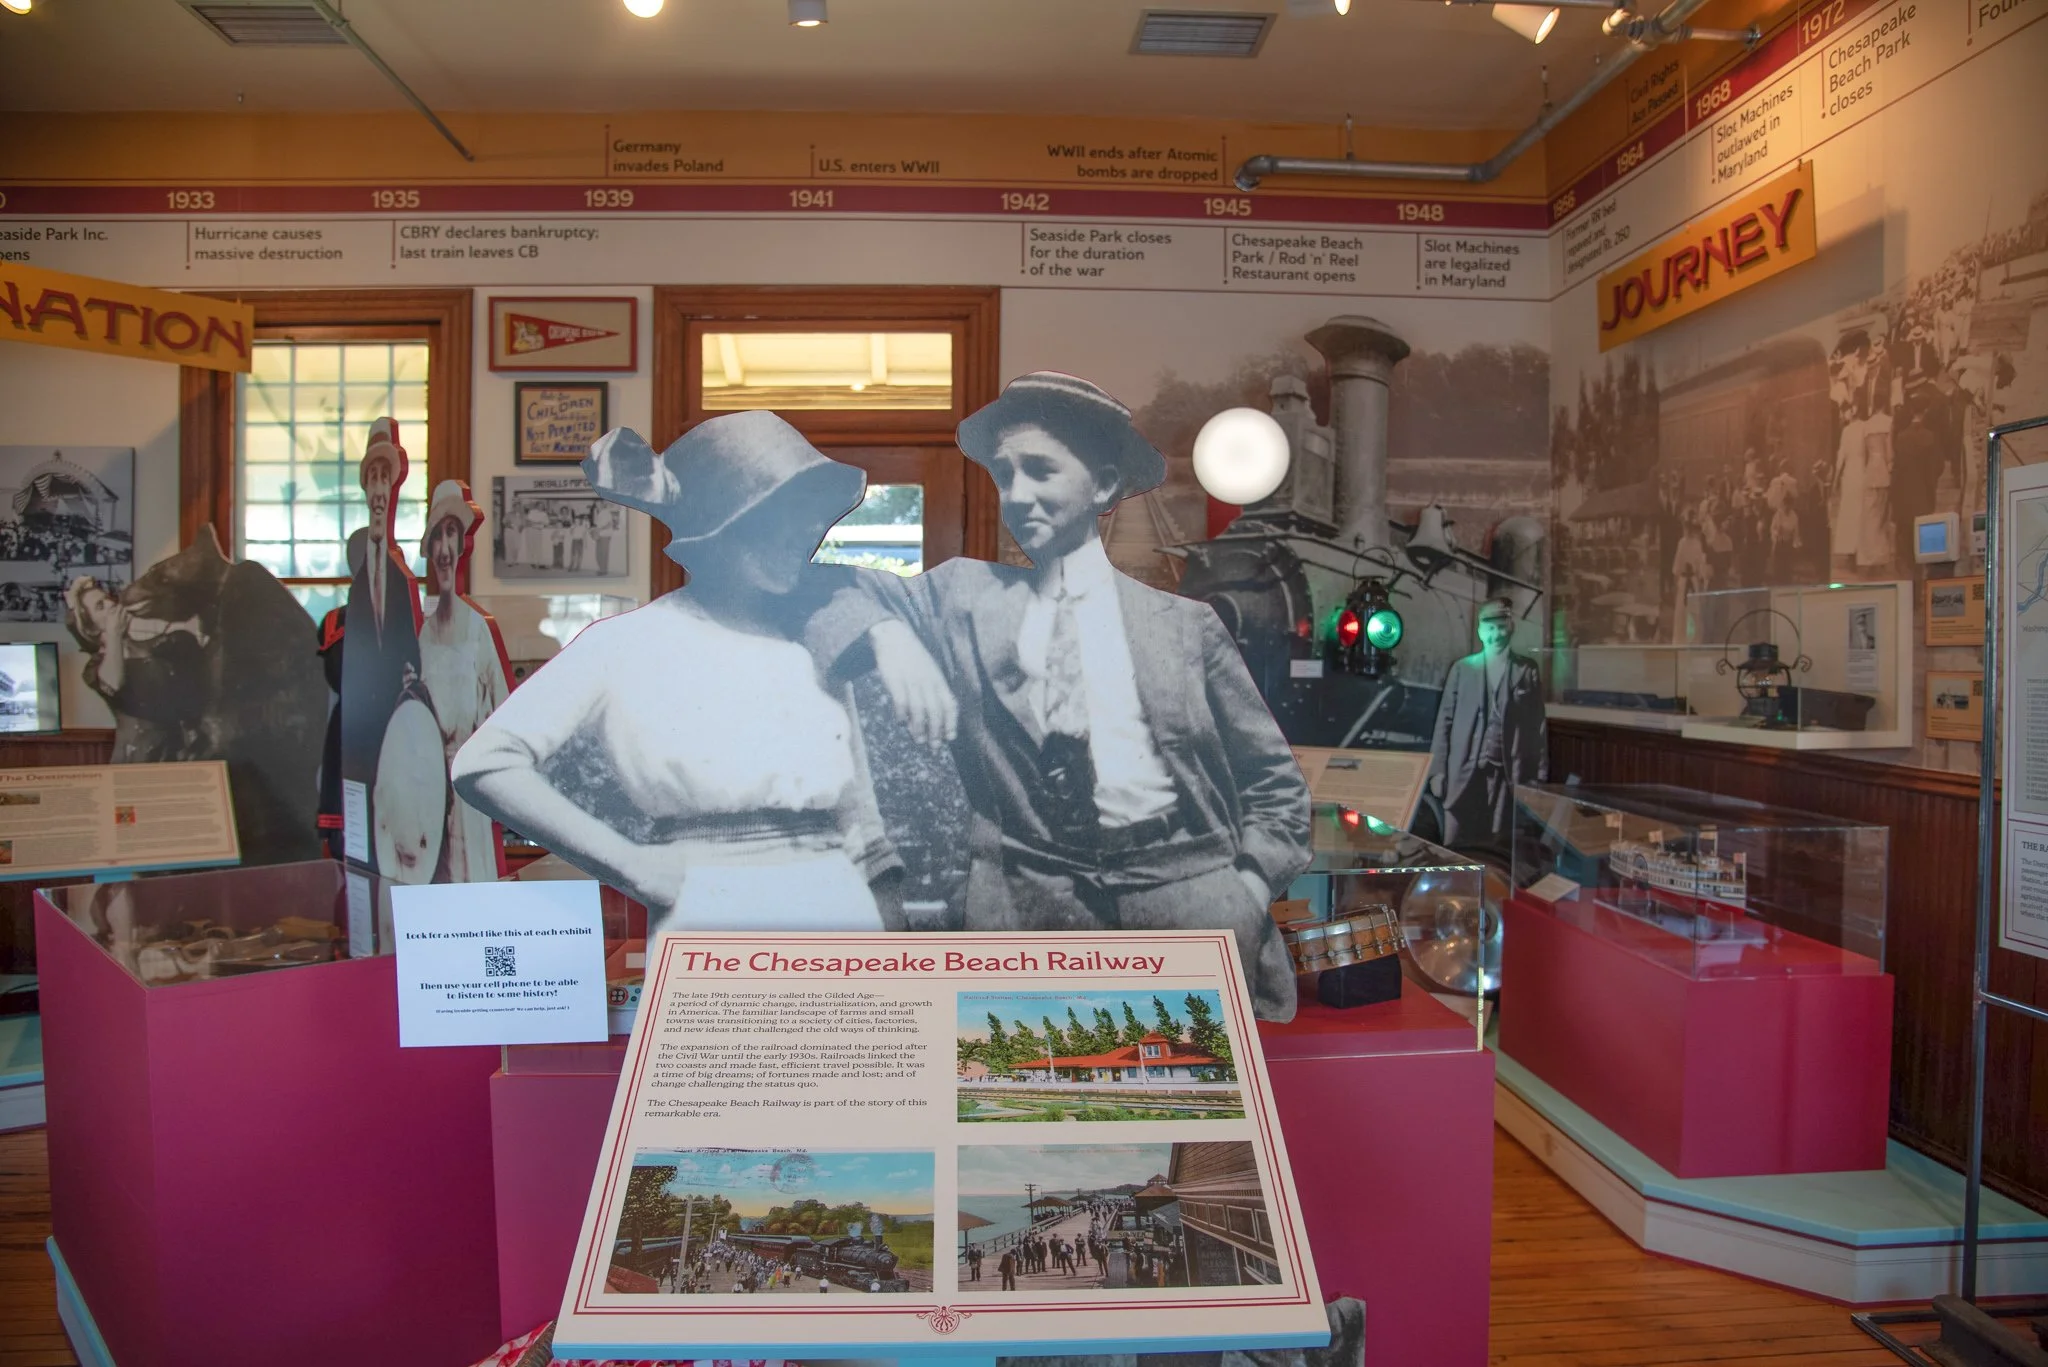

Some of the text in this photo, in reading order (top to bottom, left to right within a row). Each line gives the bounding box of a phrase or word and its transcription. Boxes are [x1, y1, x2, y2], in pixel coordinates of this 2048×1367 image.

[1802, 1, 1845, 44] 1972
[1829, 4, 1916, 69] Chesapeake
[1829, 30, 1911, 93] Beach Park
[1696, 79, 1731, 119] 1968
[1829, 81, 1872, 116] closes
[1716, 85, 1793, 143] Slot Machines
[613, 140, 681, 155] Germany
[1717, 115, 1780, 163] outlawed in
[1047, 145, 1218, 162] WWII ends after Atomic
[1617, 141, 1644, 175] 1964
[1718, 140, 1767, 184] Maryland
[613, 159, 724, 173] invades Poland
[819, 160, 940, 173] U.S. enters WWII
[1077, 165, 1218, 182] bombs are dropped
[167, 191, 215, 209] 1933
[372, 190, 420, 208] 1935
[584, 189, 634, 207] 1939
[789, 190, 834, 207] 1941
[1000, 193, 1050, 211] 1942
[1204, 198, 1252, 217] 1945
[1397, 204, 1444, 221] 1948
[46, 227, 79, 241] Park
[83, 227, 109, 241] Inc.
[194, 227, 323, 241] Hurricane causes
[400, 225, 441, 239] CBRY
[445, 225, 507, 239] declares
[1029, 228, 1172, 245] Seaside Park closes
[1232, 233, 1363, 251] Chesapeake Beach
[1424, 240, 1520, 256] Slot Machines
[194, 247, 343, 261] massive destruction
[400, 245, 539, 259] last train leaves CB
[1030, 246, 1145, 261] for the duration
[1232, 251, 1264, 265] Park
[1279, 252, 1306, 266] Rod
[1329, 253, 1359, 267] Reel
[1602, 188, 1803, 331] JOURNEY
[1030, 263, 1105, 277] of the war
[1424, 256, 1511, 272] are legalized
[1232, 266, 1356, 284] Restaurant opens
[1424, 273, 1506, 290] in Maryland
[406, 932, 427, 940] Look
[451, 931, 484, 939] symbol
[485, 930, 503, 938] like
[504, 929, 522, 937] this
[535, 928, 558, 936] each
[559, 927, 593, 935] exhibit
[682, 951, 1165, 976] The Chesapeake Beach Railway
[419, 982, 443, 990] Then
[502, 980, 532, 989] phone
[544, 979, 556, 987] be
[447, 992, 457, 1000] to
[458, 991, 484, 999] listen
[486, 991, 496, 999] to
[523, 989, 558, 998] history!
[856, 992, 885, 1000] Age—
[677, 1000, 708, 1008] period
[720, 1000, 760, 1008] dynamic
[762, 1000, 798, 1008] change,
[899, 1000, 933, 1008] growth
[779, 1009, 827, 1017] landscape
[644, 1110, 701, 1118] remarkable
